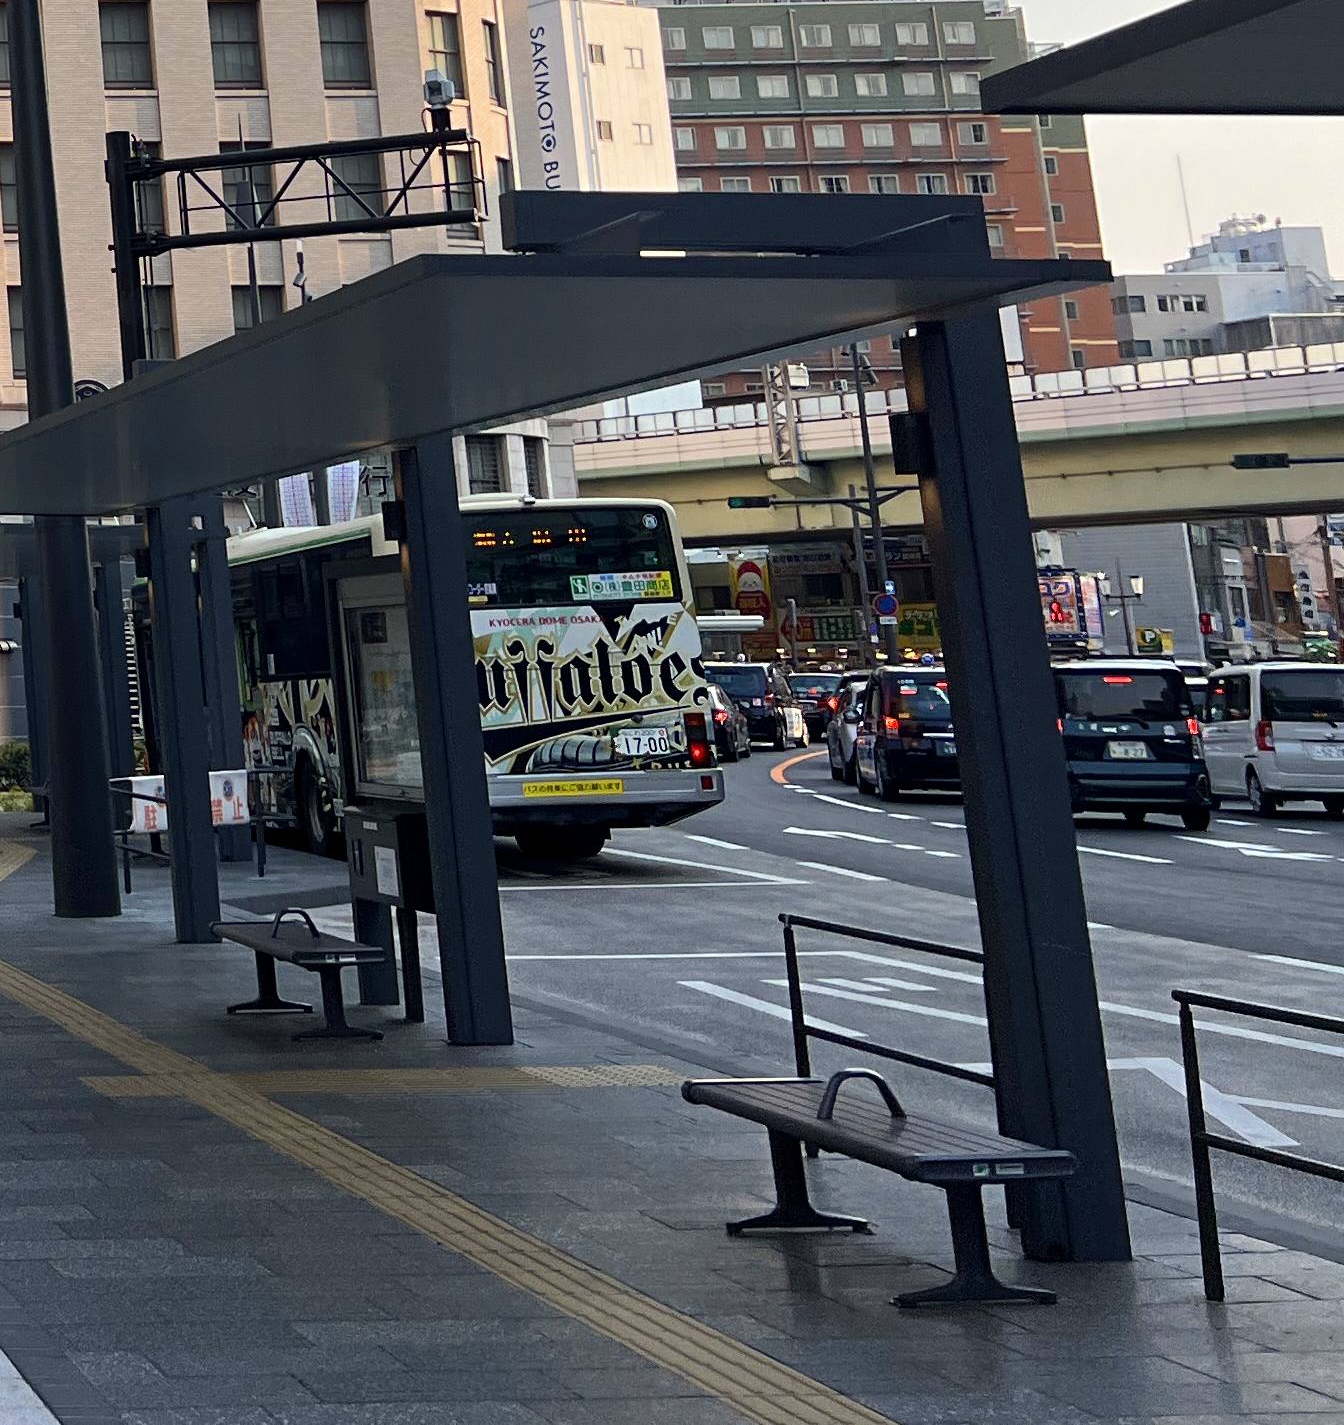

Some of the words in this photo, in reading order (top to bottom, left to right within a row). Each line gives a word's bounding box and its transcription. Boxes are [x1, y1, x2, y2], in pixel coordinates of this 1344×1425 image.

[529, 25, 558, 154] SAKIMOTO
[489, 617, 536, 628] KYOCERA
[539, 616, 568, 626] DOME
[474, 636, 709, 723] uffaloes
[624, 736, 668, 754] 17-00
